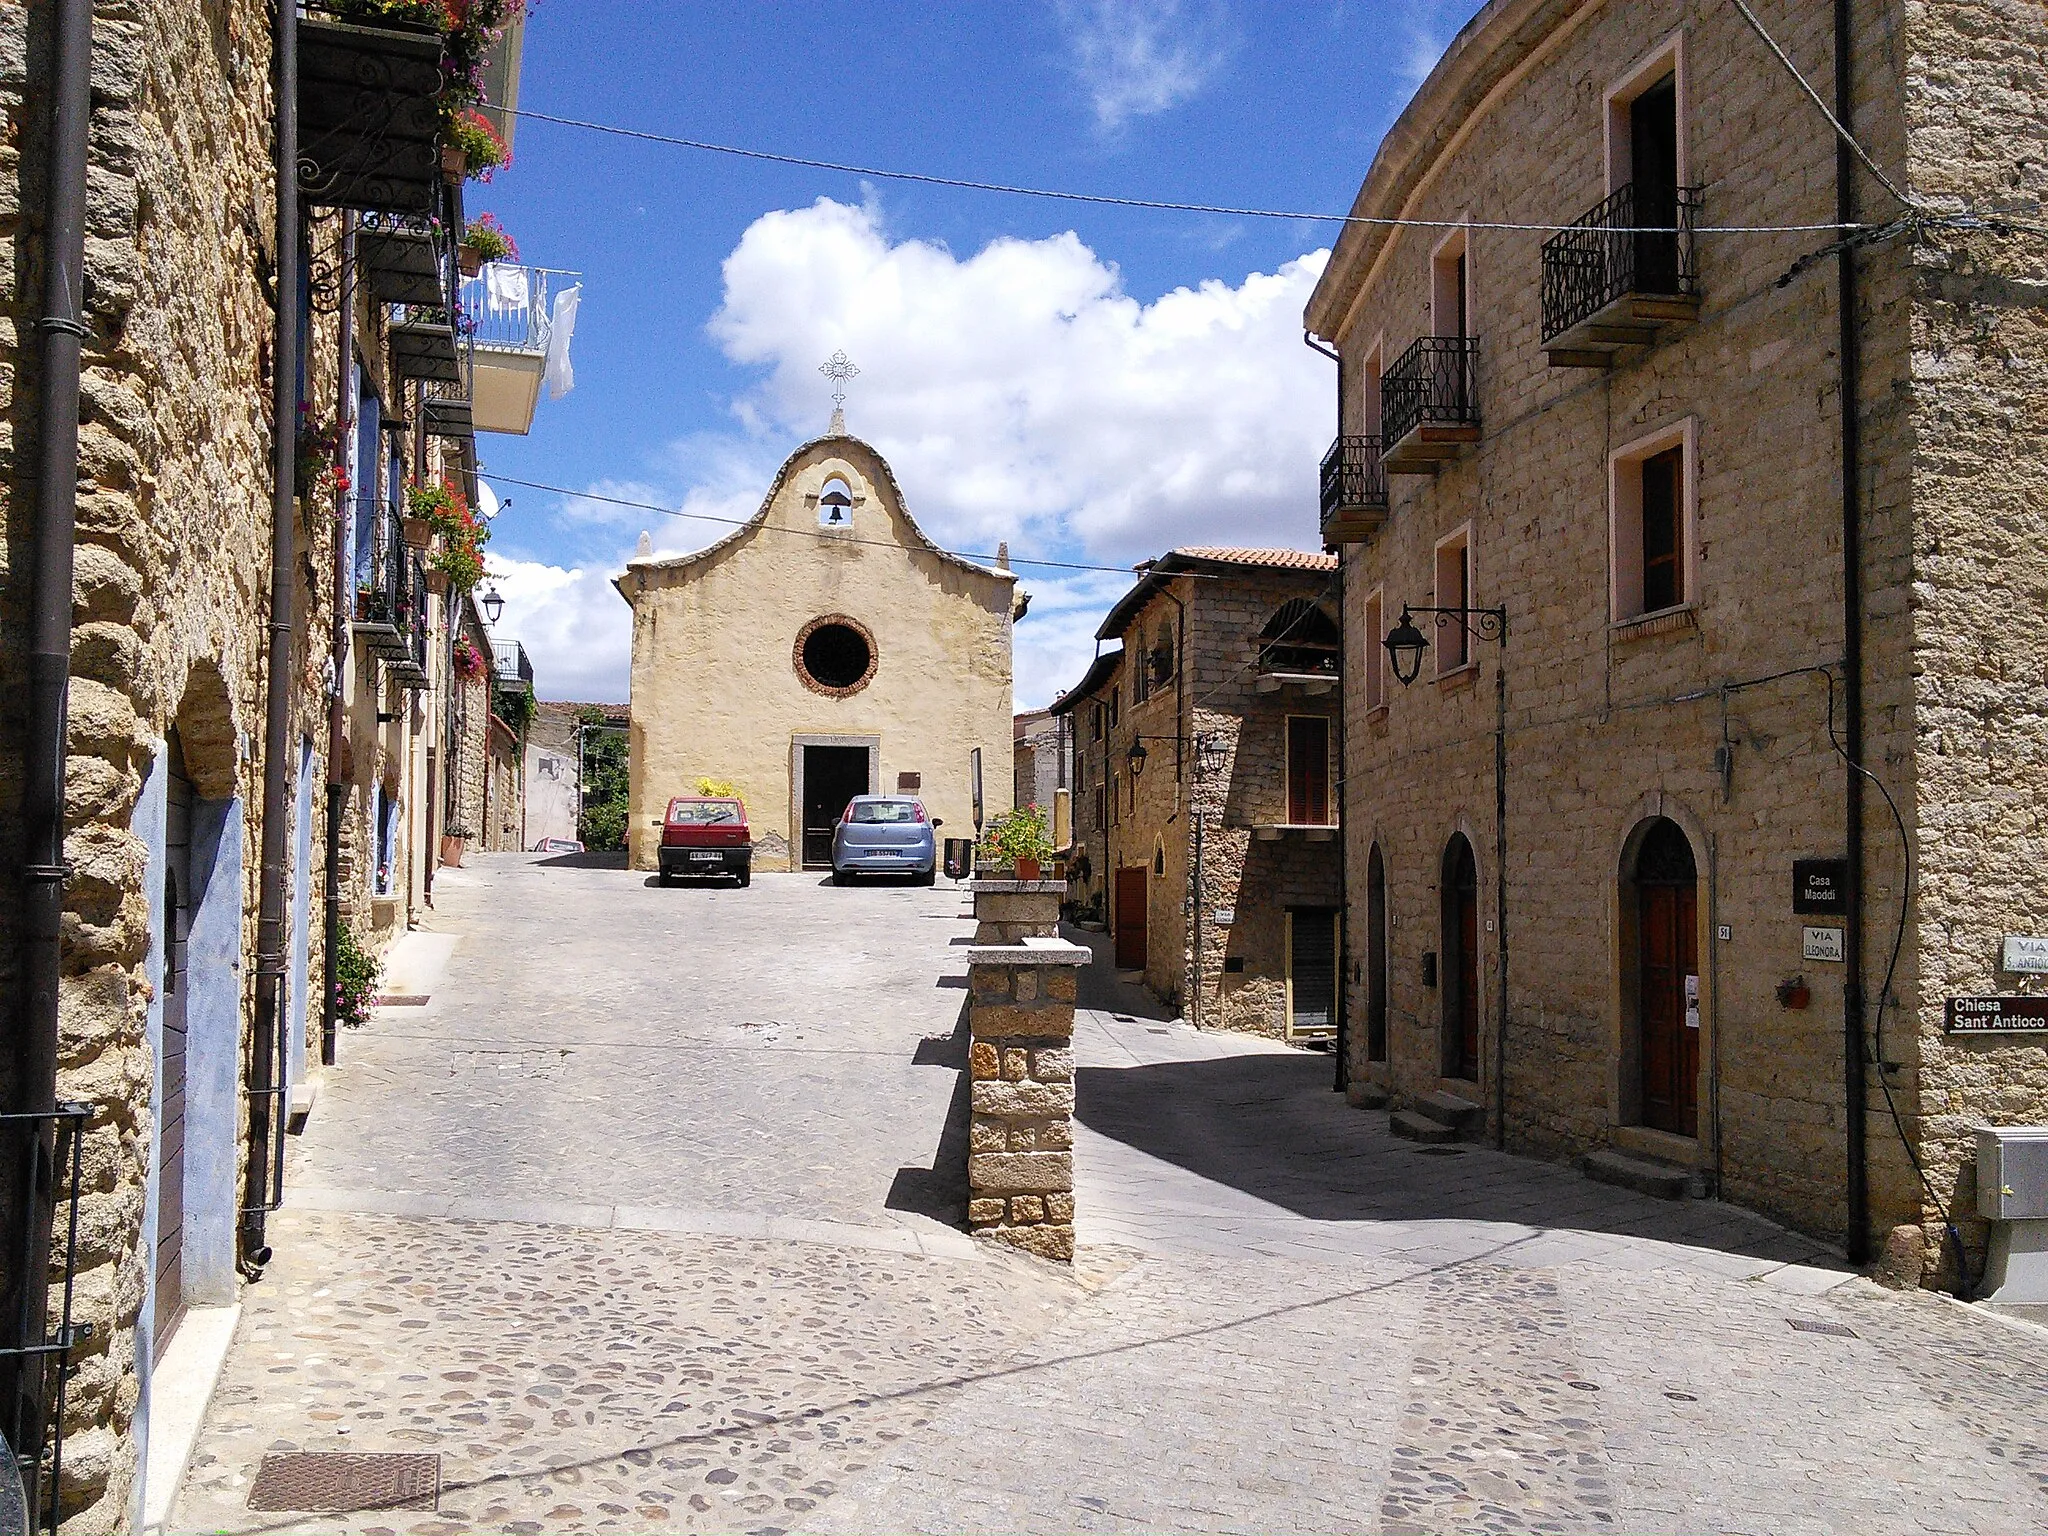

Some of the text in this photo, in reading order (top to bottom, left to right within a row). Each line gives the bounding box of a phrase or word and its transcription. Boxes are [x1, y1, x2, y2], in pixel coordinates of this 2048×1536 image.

[1809, 874, 1831, 886] Casa
[1804, 888, 1836, 900] Maoddi
[1811, 931, 1833, 942] VIA
[1805, 944, 1840, 958] ELEONORA
[2017, 941, 2047, 952] VIA
[1954, 998, 2001, 1012] Chiesa
[1954, 1014, 2046, 1028] Sant' Antioco
